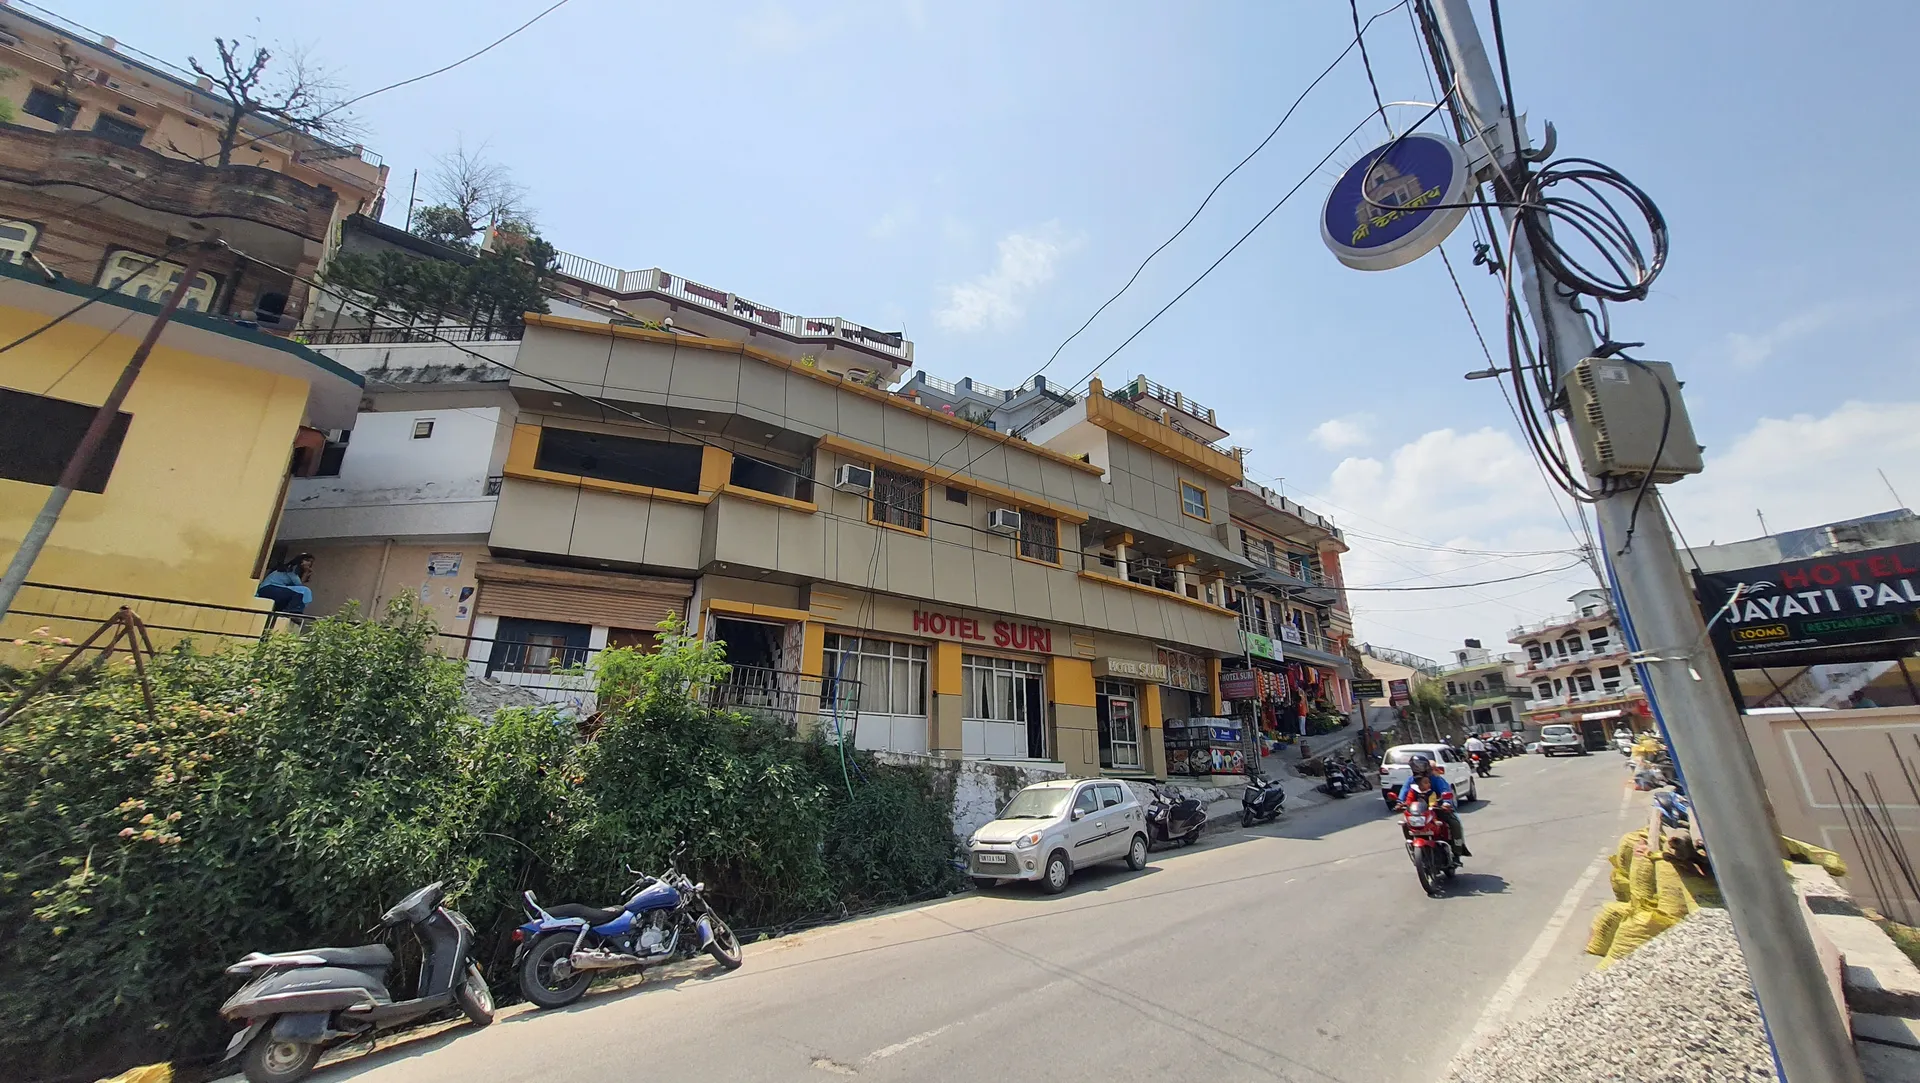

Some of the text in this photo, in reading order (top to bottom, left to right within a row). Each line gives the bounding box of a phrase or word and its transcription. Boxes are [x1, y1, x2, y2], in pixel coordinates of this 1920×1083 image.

[1351, 223, 1370, 246] श्री
[1780, 554, 1918, 588] HOTEL
[1727, 589, 1840, 623] JAYATI
[913, 610, 1052, 652] HOTEL SURI
[1739, 615, 1893, 639] ROOMS RESTAURANT
[1108, 660, 1167, 679] HOTEL SURI
[1221, 671, 1254, 681] HOTEL SURI
